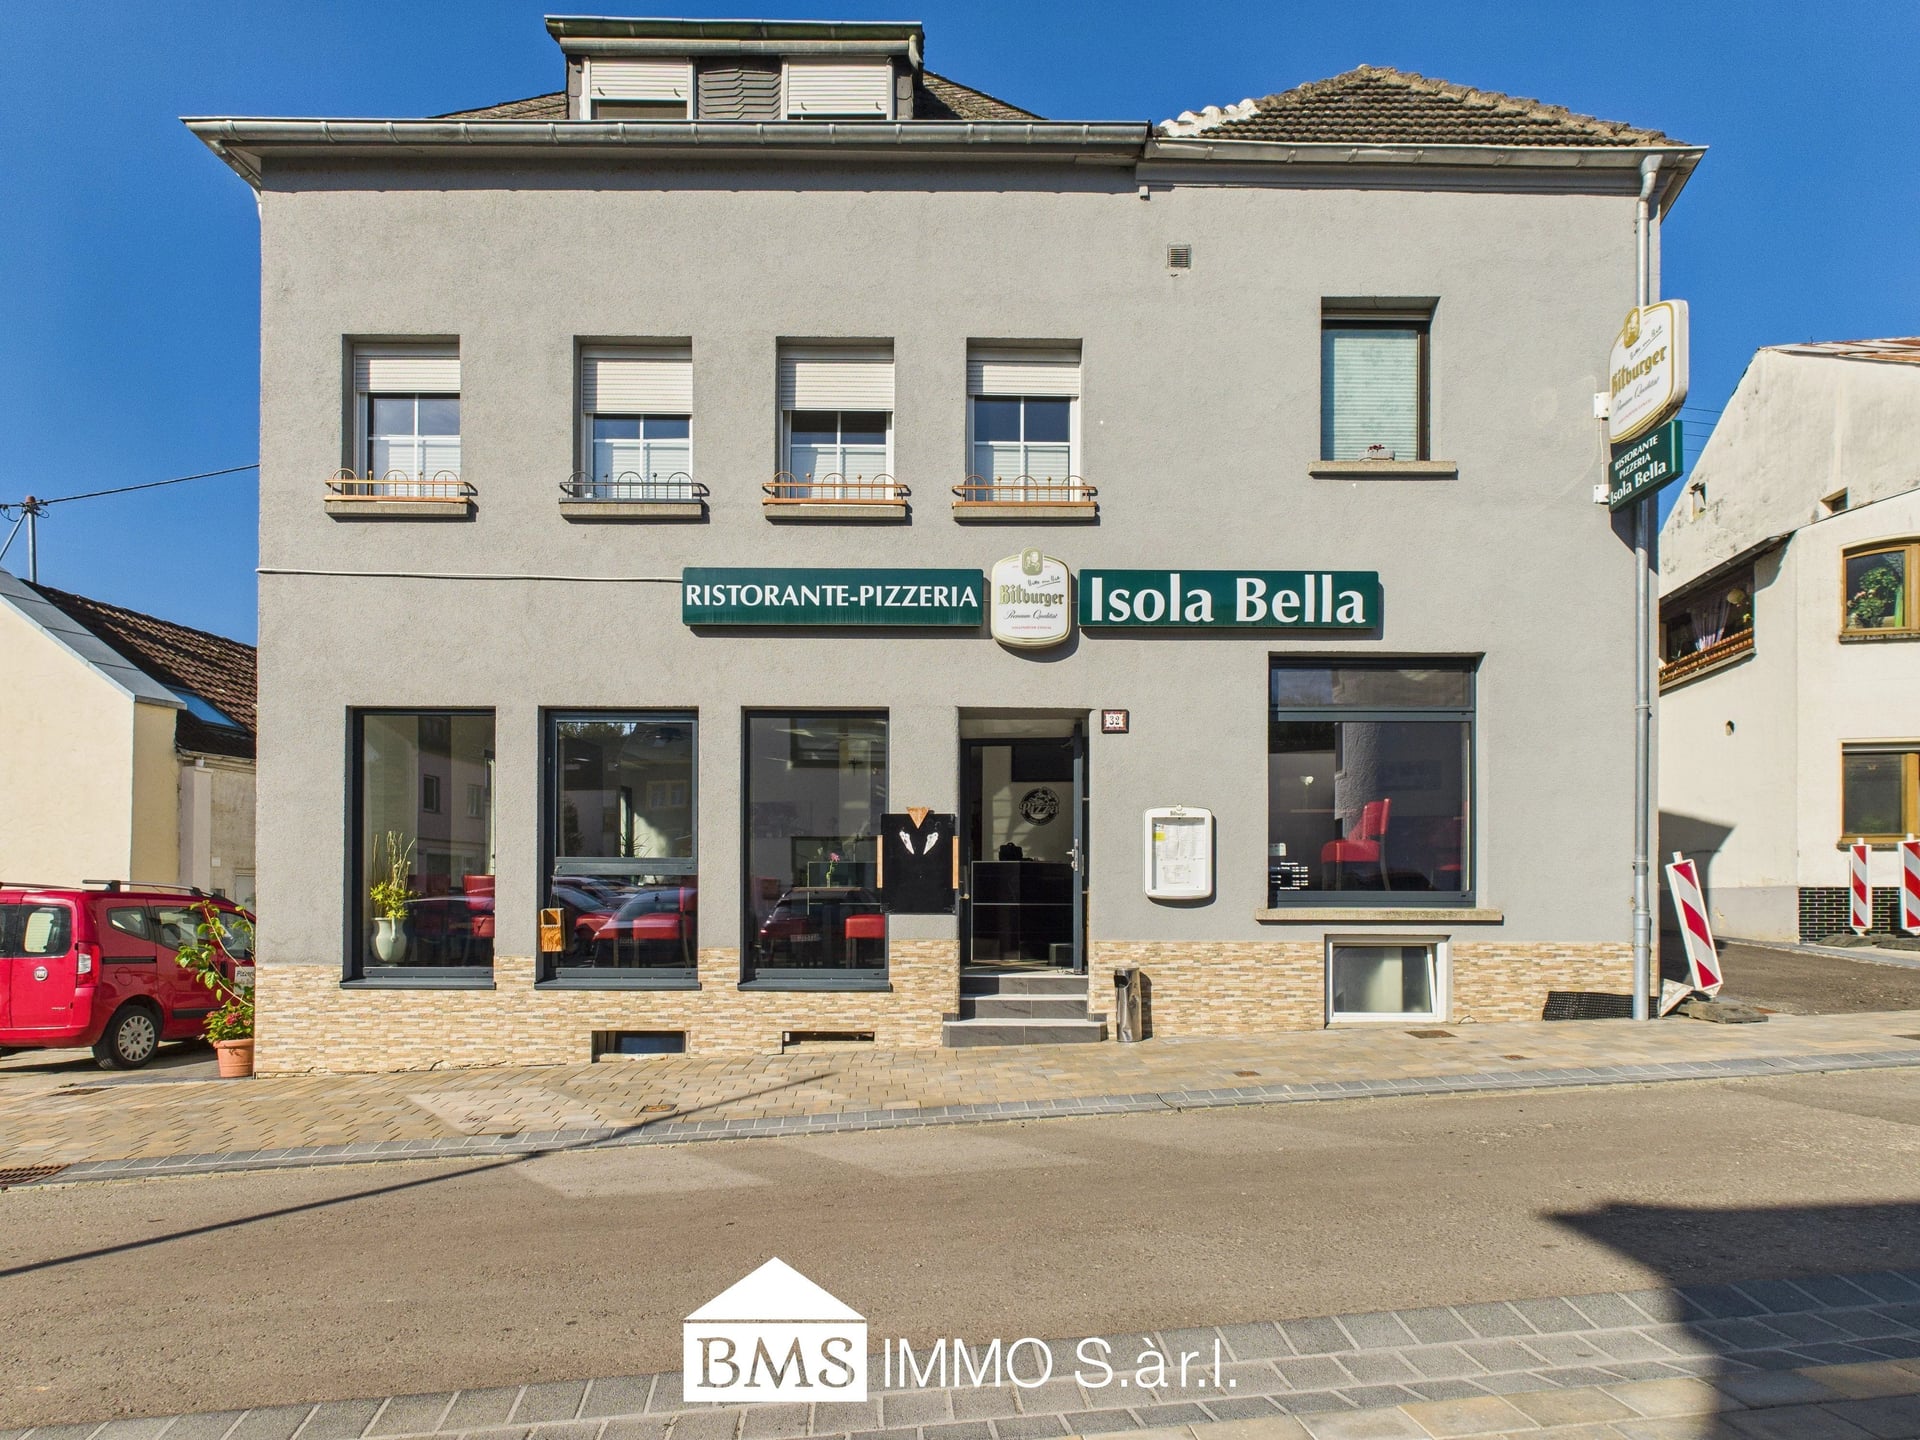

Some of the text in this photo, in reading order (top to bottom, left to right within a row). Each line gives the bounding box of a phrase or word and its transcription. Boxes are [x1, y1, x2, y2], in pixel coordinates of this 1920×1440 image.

[1611, 346, 1667, 400] Bitburger
[1614, 434, 1659, 471] RISTORANTE
[1619, 452, 1651, 480] PIZZERIA
[1610, 460, 1667, 505] Isola Bella
[686, 583, 979, 607] RISTORANTE-PIZZERIA
[999, 584, 1064, 607] Bitburger
[1091, 573, 1367, 624] Isola Bella
[1109, 715, 1120, 726] 32
